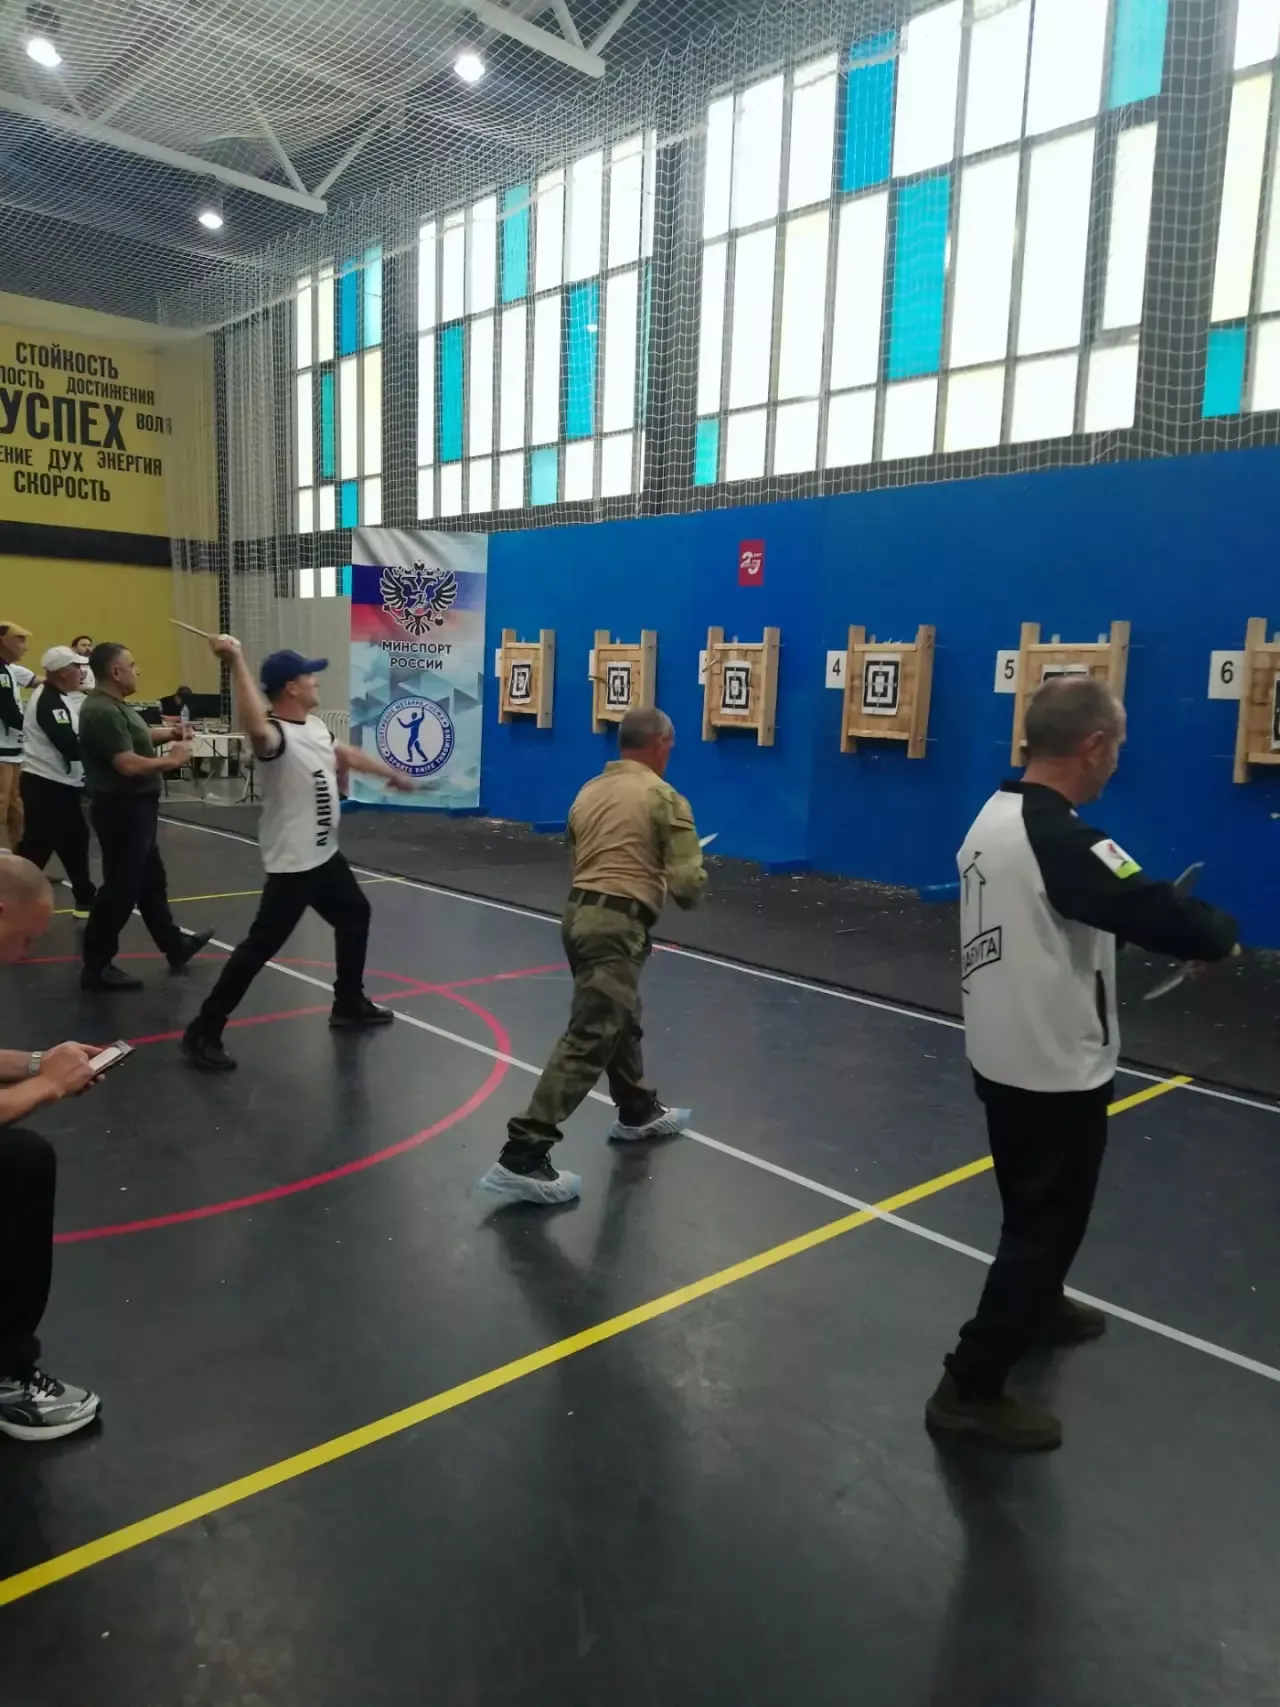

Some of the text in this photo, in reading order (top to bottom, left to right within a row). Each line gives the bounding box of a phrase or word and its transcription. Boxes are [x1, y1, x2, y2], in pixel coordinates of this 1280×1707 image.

[16, 342, 119, 380] СТОЙКОСТЬ
[66, 376, 155, 406] ДОСТИЖЕНИЯ
[0, 387, 126, 451] УСПЕХ
[48, 448, 83, 473] ДУХ
[97, 451, 162, 477] ЭНЕРГИЯ
[14, 470, 111, 502] СКОРОСТЬ
[382, 640, 452, 655] МИНСПОРТ
[390, 657, 443, 670] РОССИИ
[832, 657, 841, 677] 4
[1004, 658, 1015, 680] 5
[1221, 660, 1234, 684] 6
